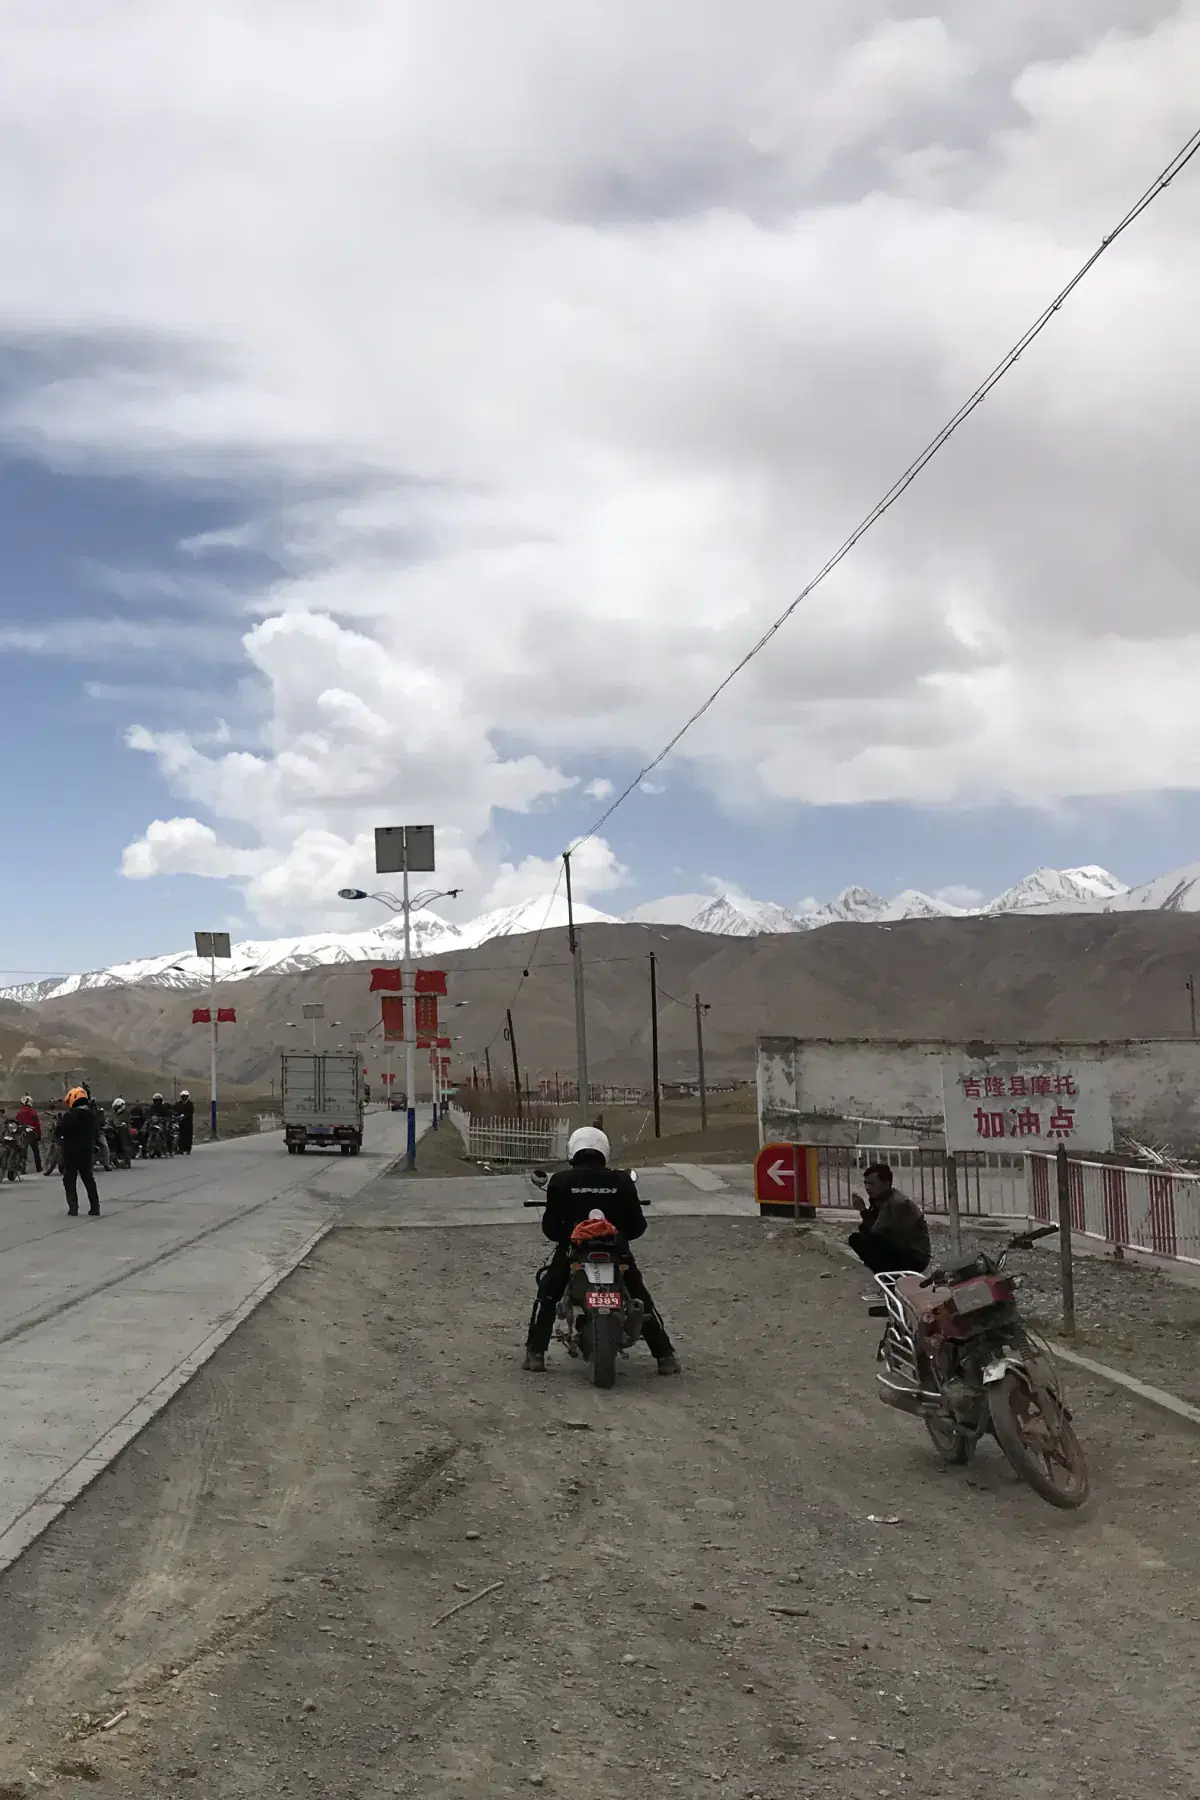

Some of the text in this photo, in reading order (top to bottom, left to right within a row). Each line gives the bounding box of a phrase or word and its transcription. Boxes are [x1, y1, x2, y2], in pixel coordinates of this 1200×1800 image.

[963, 1075, 1076, 1098] 吉隆县摩托
[973, 1106, 1075, 1138] 加油点
